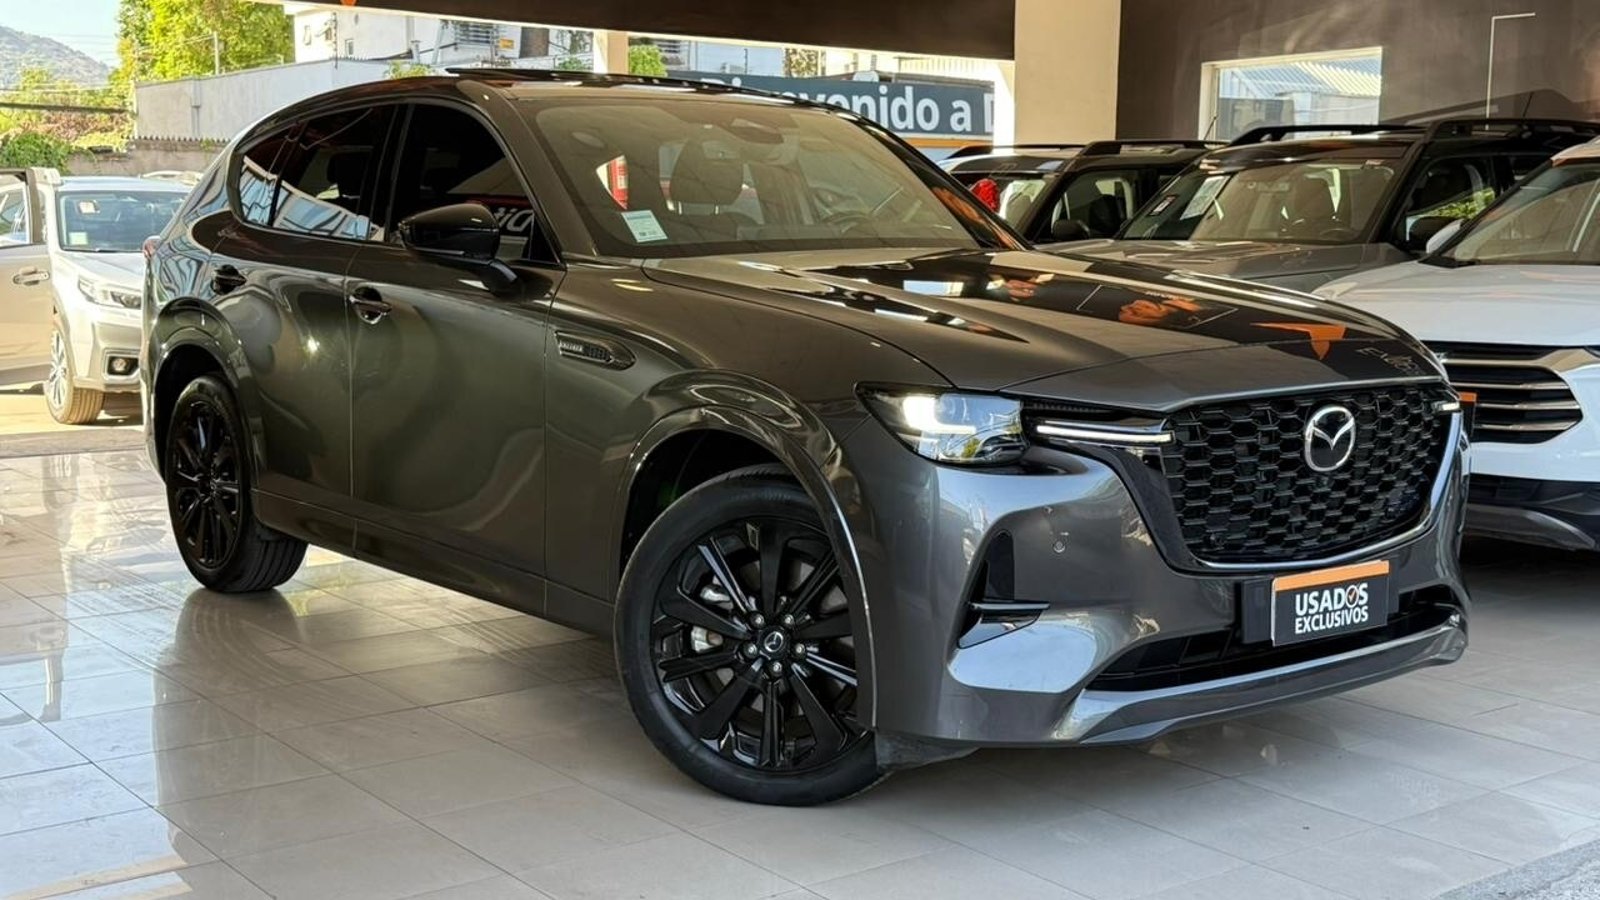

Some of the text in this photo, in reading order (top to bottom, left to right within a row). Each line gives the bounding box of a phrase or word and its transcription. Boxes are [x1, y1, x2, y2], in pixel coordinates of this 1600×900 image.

[950, 99, 972, 132] a
[1295, 583, 1368, 617] USADOS
[1295, 606, 1368, 634] EXCLUSIVOS
